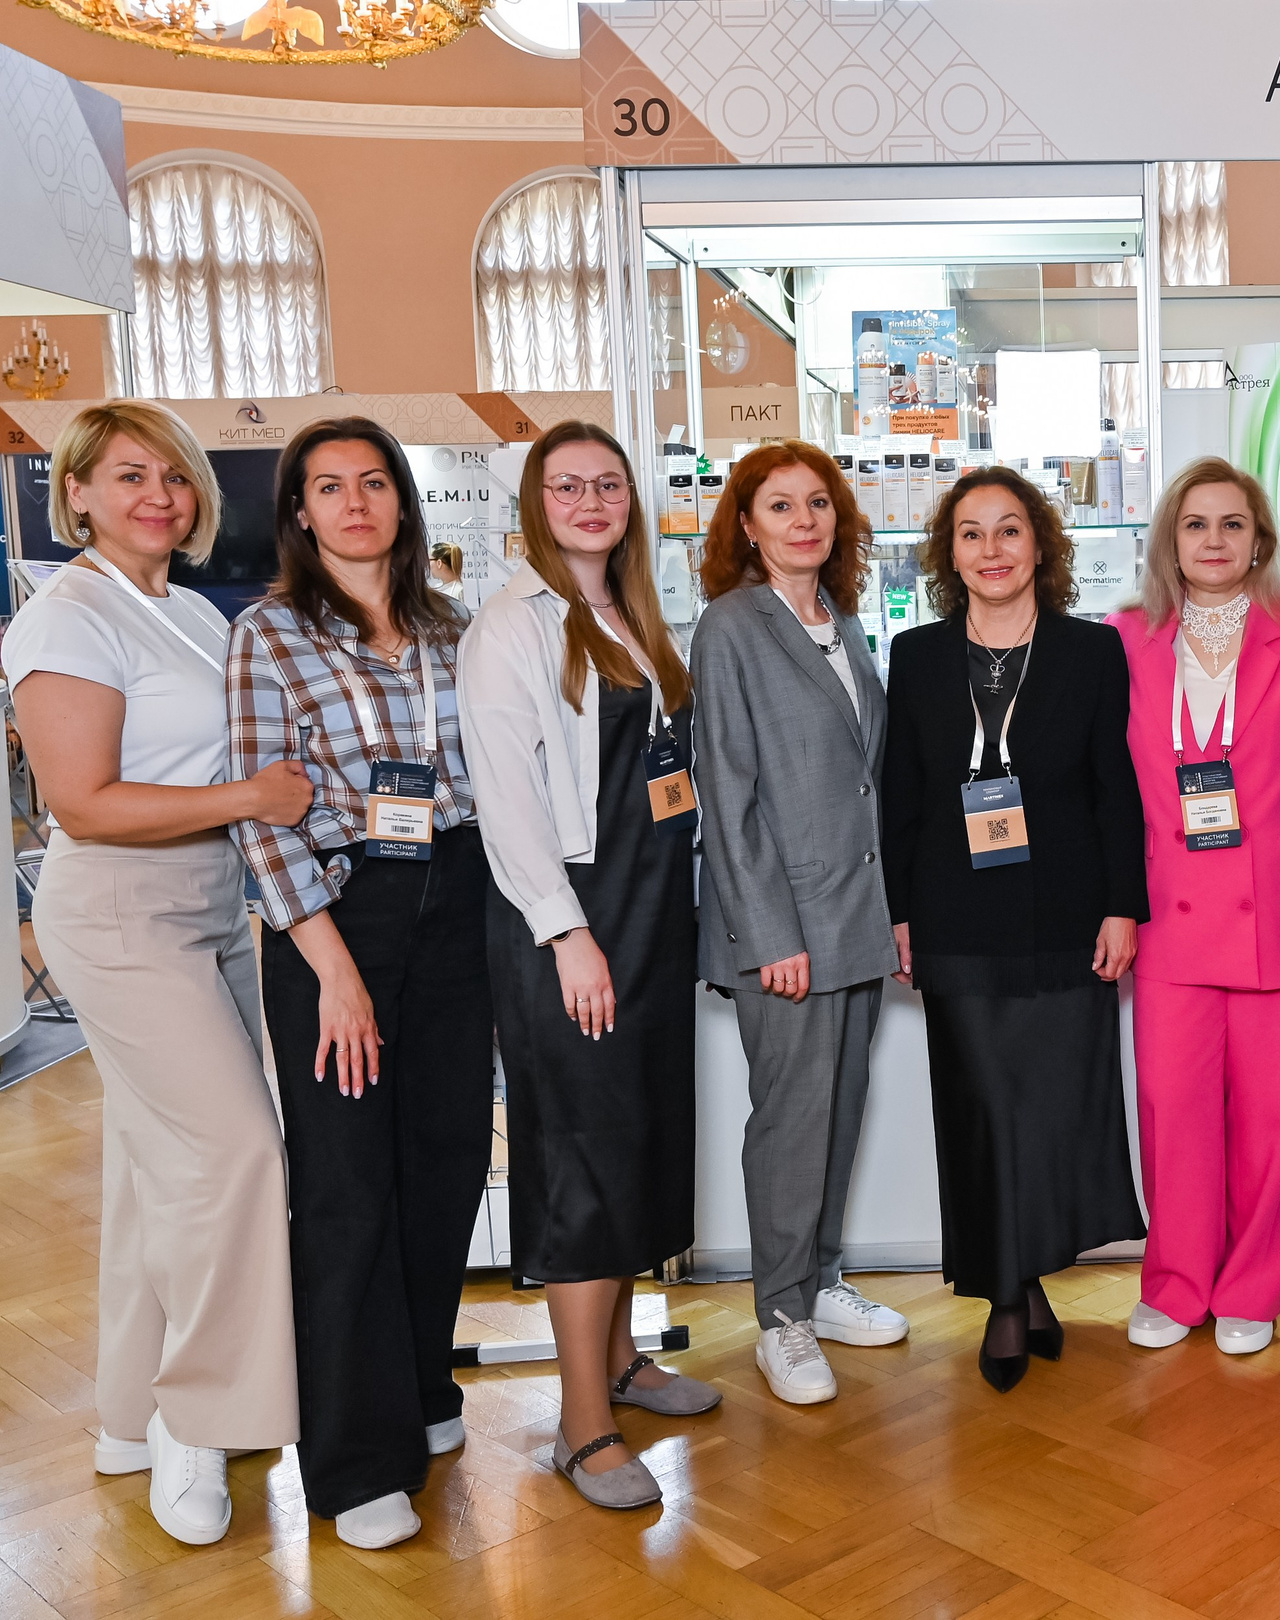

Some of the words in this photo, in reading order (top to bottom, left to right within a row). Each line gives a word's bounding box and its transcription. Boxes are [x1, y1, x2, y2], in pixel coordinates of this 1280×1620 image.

[611, 97, 671, 138] 30
[927, 319, 950, 328] Spray
[730, 404, 781, 422] ПАКТ
[219, 428, 248, 439] КИТ
[252, 428, 285, 438] MED
[516, 422, 529, 434] 31
[8, 431, 24, 444] 32
[1197, 833, 1229, 841] УЧАСТНИК
